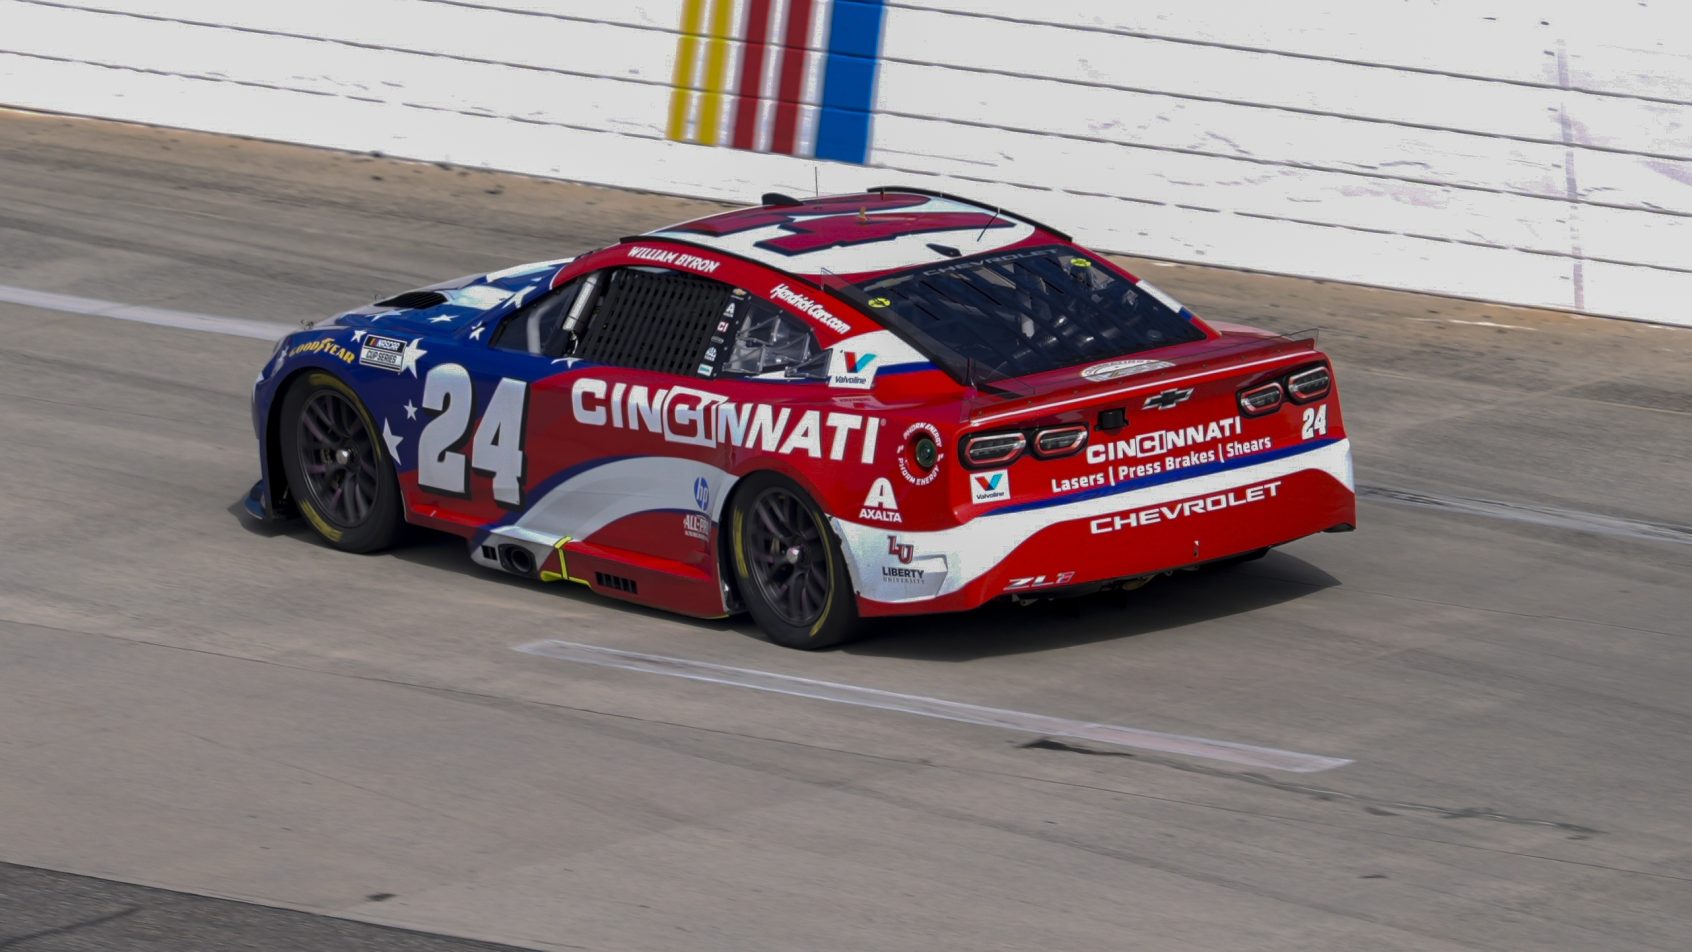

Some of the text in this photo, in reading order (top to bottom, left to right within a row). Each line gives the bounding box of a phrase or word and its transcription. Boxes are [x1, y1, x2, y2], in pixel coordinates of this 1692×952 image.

[628, 246, 720, 273] WILLIAM BYRON
[923, 249, 1057, 276] CHEVROLET
[288, 337, 356, 364] GOODYEAR
[365, 350, 398, 364] CUP SERIES
[376, 339, 401, 351] NASCAR
[835, 375, 867, 385] Valvoline
[417, 362, 528, 506] 24
[571, 378, 880, 464] CINCINNATI
[1302, 404, 1328, 440] 24
[1086, 416, 1242, 464] CINCINNATI
[1051, 472, 1105, 493] Lasers
[1118, 460, 1162, 481] Press
[1165, 449, 1215, 470] Brakes
[1226, 437, 1272, 458] Shears
[696, 477, 708, 512] hp
[1090, 481, 1282, 534] CHEVROLET
[859, 508, 902, 522] AXALTA
[882, 567, 924, 579] LIBERTY
